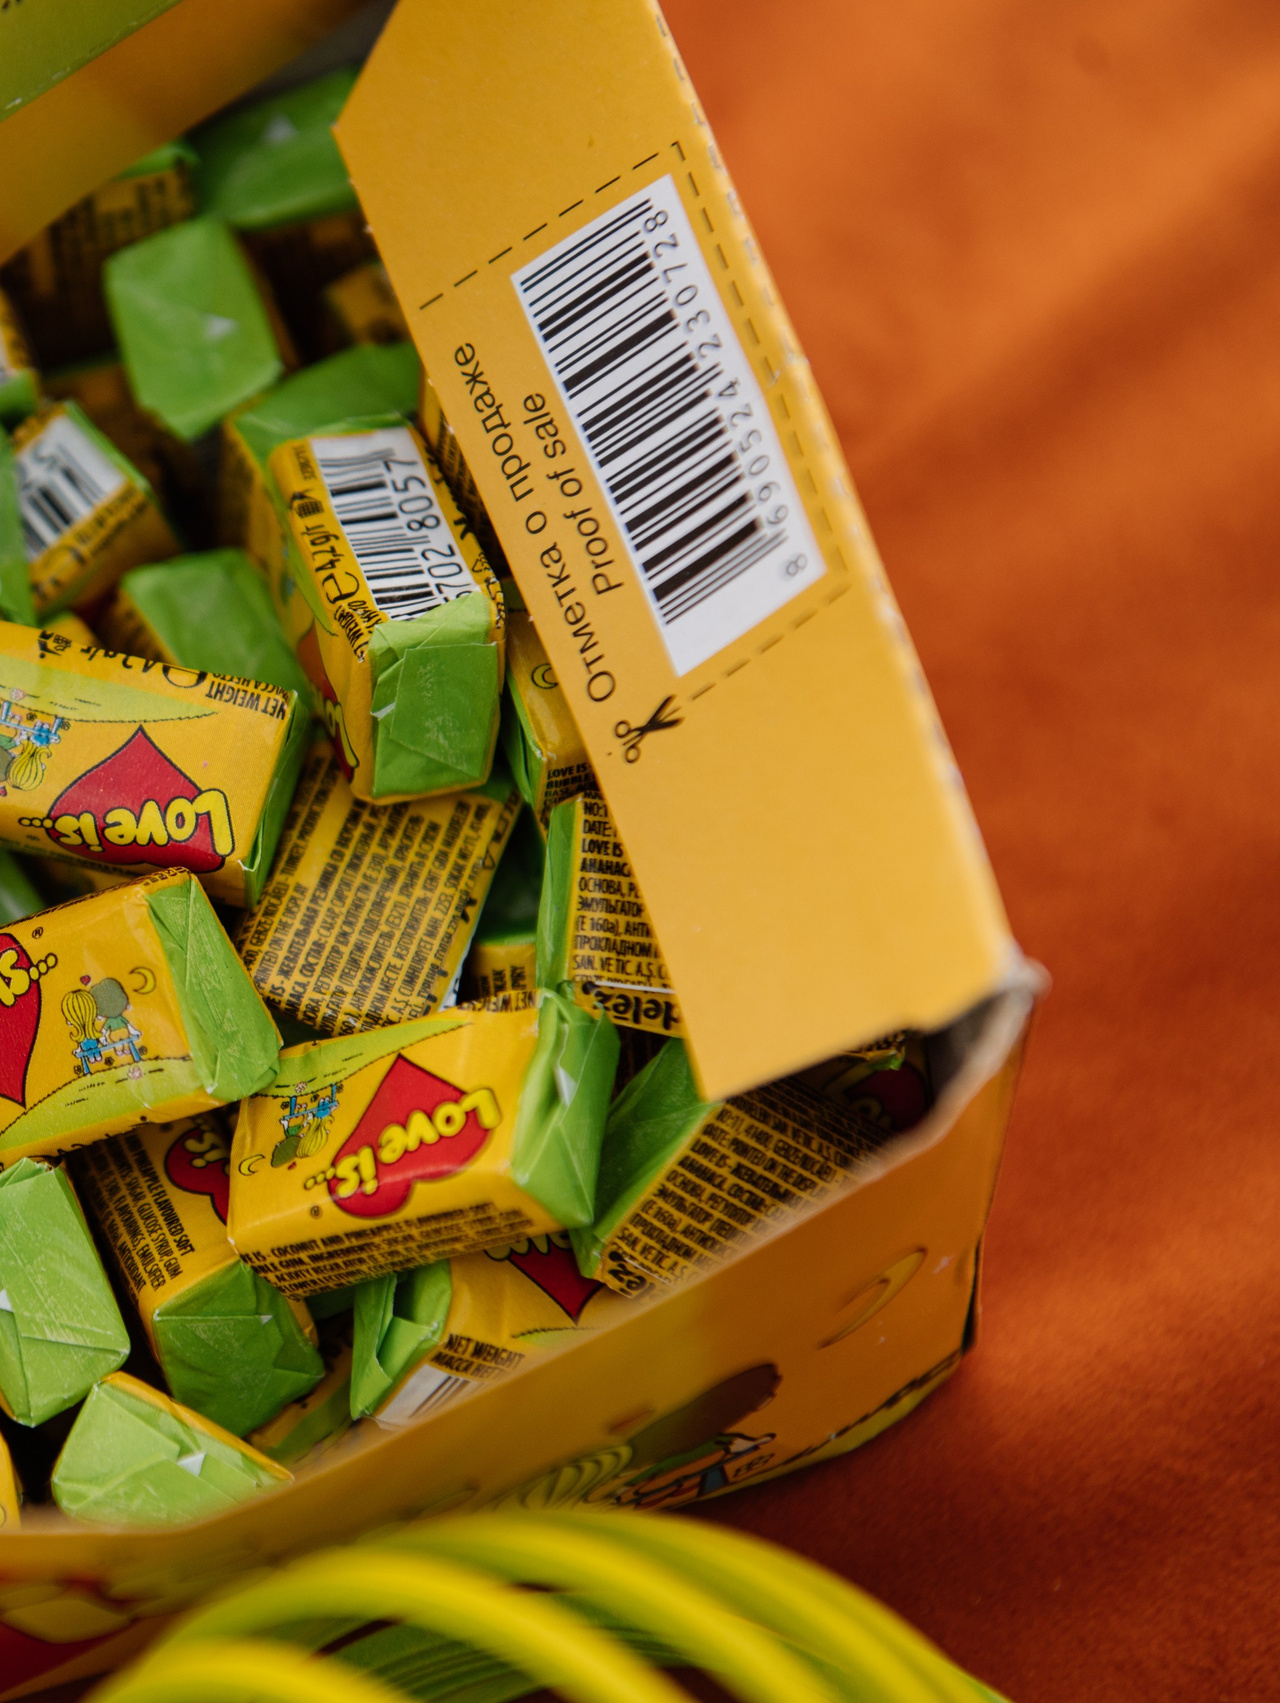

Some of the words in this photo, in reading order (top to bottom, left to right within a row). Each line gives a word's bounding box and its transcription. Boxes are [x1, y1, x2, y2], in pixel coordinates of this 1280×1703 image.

[643, 211, 721, 358] 230728
[455, 344, 533, 501] продаже
[523, 393, 566, 459] sale
[382, 458, 441, 532] 8057
[546, 468, 583, 498] of
[525, 511, 547, 535] о
[564, 508, 623, 595] Proof
[540, 543, 615, 702] Отметка
[206, 681, 261, 711] WEIGHT
[103, 787, 236, 859] Love
[582, 838, 610, 856] LOVE
[612, 842, 624, 858] IS
[377, 1086, 504, 1165] Love
[136, 1202, 163, 1237] GLUCOSE
[151, 1232, 174, 1262] SYRUP,
[163, 1257, 183, 1280] GUM
[152, 1190, 184, 1237] FLAVOURED
[173, 1234, 195, 1256] SOFT
[136, 1244, 166, 1290] EMULSIFIER
[444, 1334, 473, 1355] NET
[470, 1341, 513, 1365] WEIGHT
